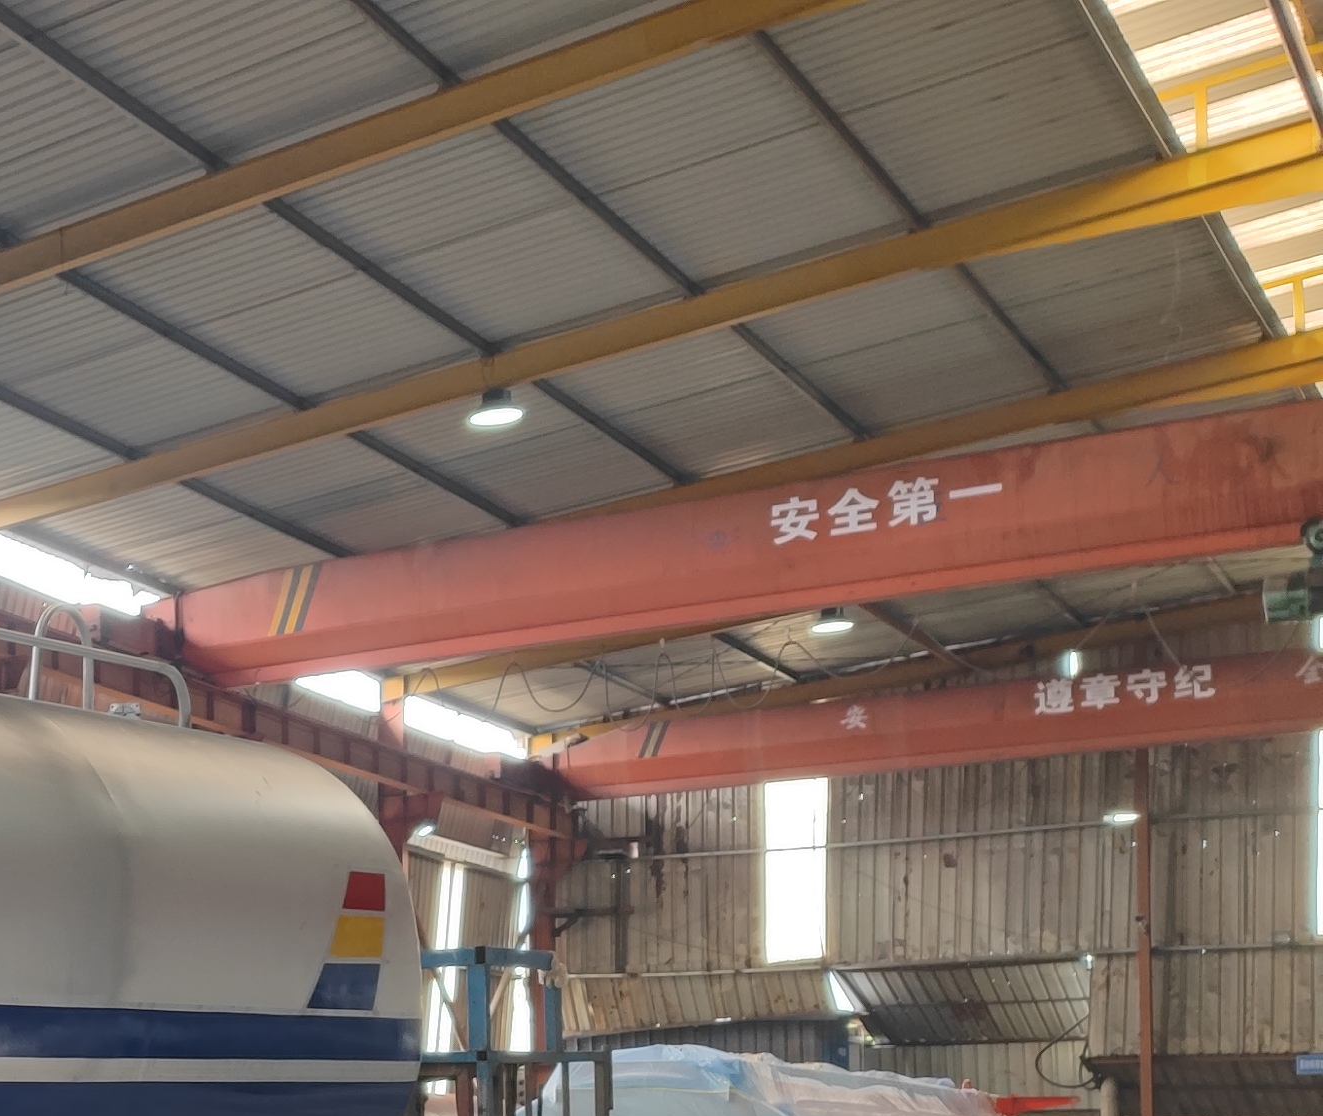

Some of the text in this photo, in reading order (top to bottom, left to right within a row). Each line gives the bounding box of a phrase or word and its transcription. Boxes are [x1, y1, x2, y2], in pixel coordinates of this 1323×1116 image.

[770, 476, 1004, 546] 安全第一
[1034, 663, 1216, 716] 遵章守纪
